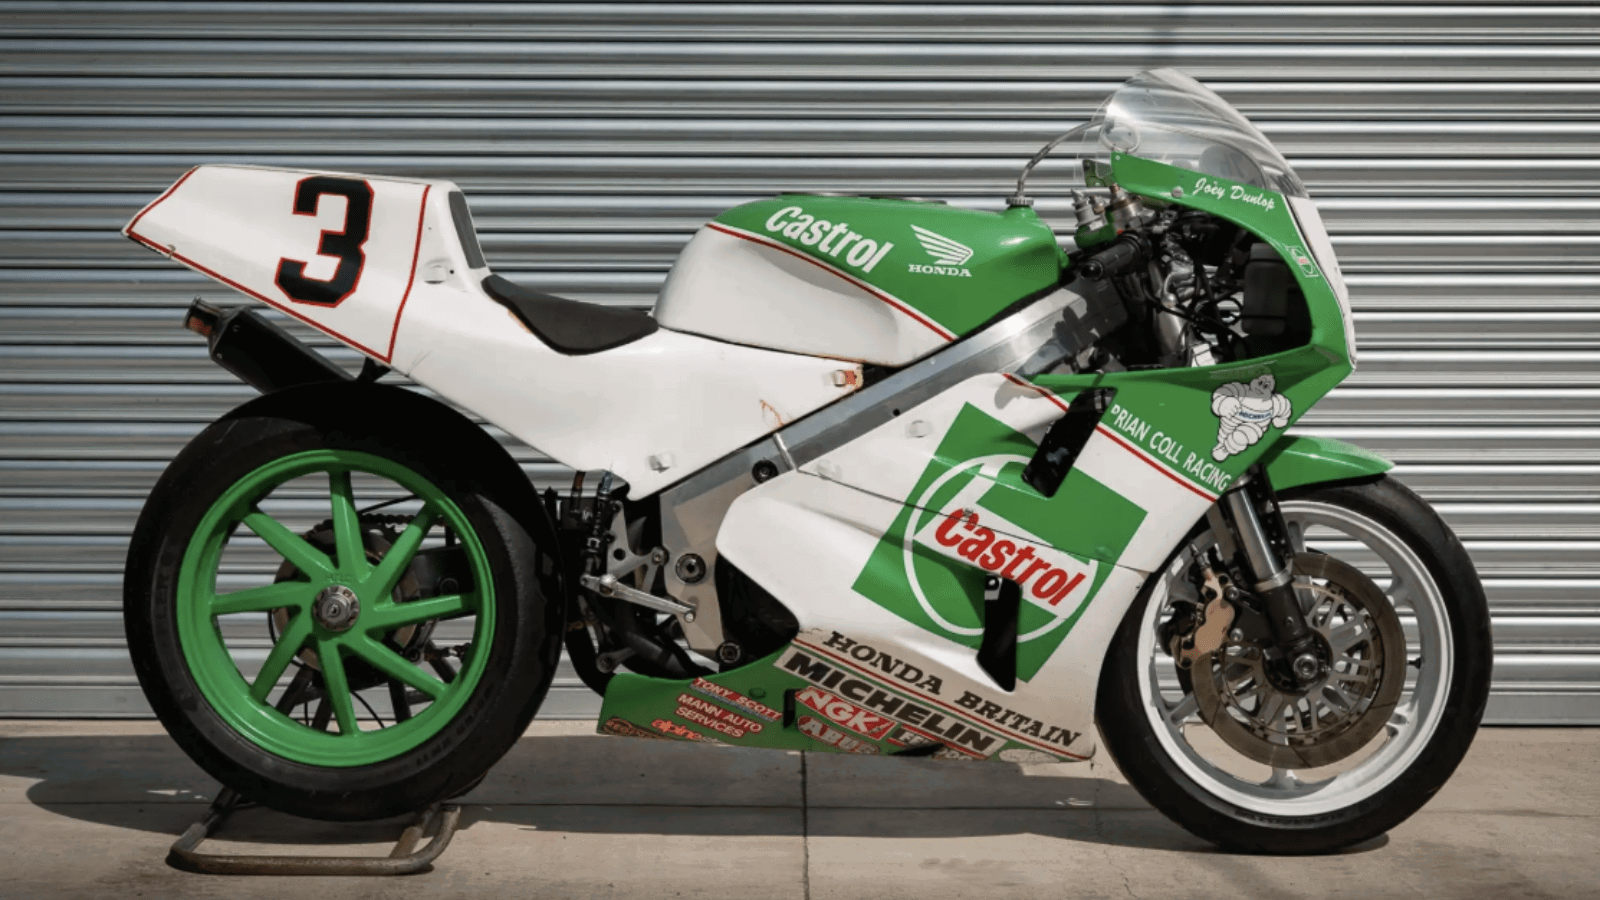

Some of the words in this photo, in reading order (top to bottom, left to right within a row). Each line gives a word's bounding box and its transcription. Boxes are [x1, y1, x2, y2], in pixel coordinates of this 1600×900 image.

[1193, 177, 1226, 200] Joey
[1230, 185, 1275, 212] Dunlop
[275, 175, 375, 308] 3
[766, 206, 894, 273] Castrol
[908, 264, 972, 277] HONDA
[1150, 431, 1183, 464] COLL
[1182, 452, 1232, 492] RACING
[935, 508, 1086, 606] Castrol
[679, 694, 723, 717] MANN
[722, 713, 763, 733] AUTO
[695, 677, 733, 697] TONY
[736, 696, 782, 720] SCOTT
[784, 652, 997, 752] MICHELIN
[800, 689, 880, 734] NGK
[823, 631, 944, 695] HONDA
[954, 691, 1082, 747] BRITAIN
[676, 706, 744, 738] SERVICES
